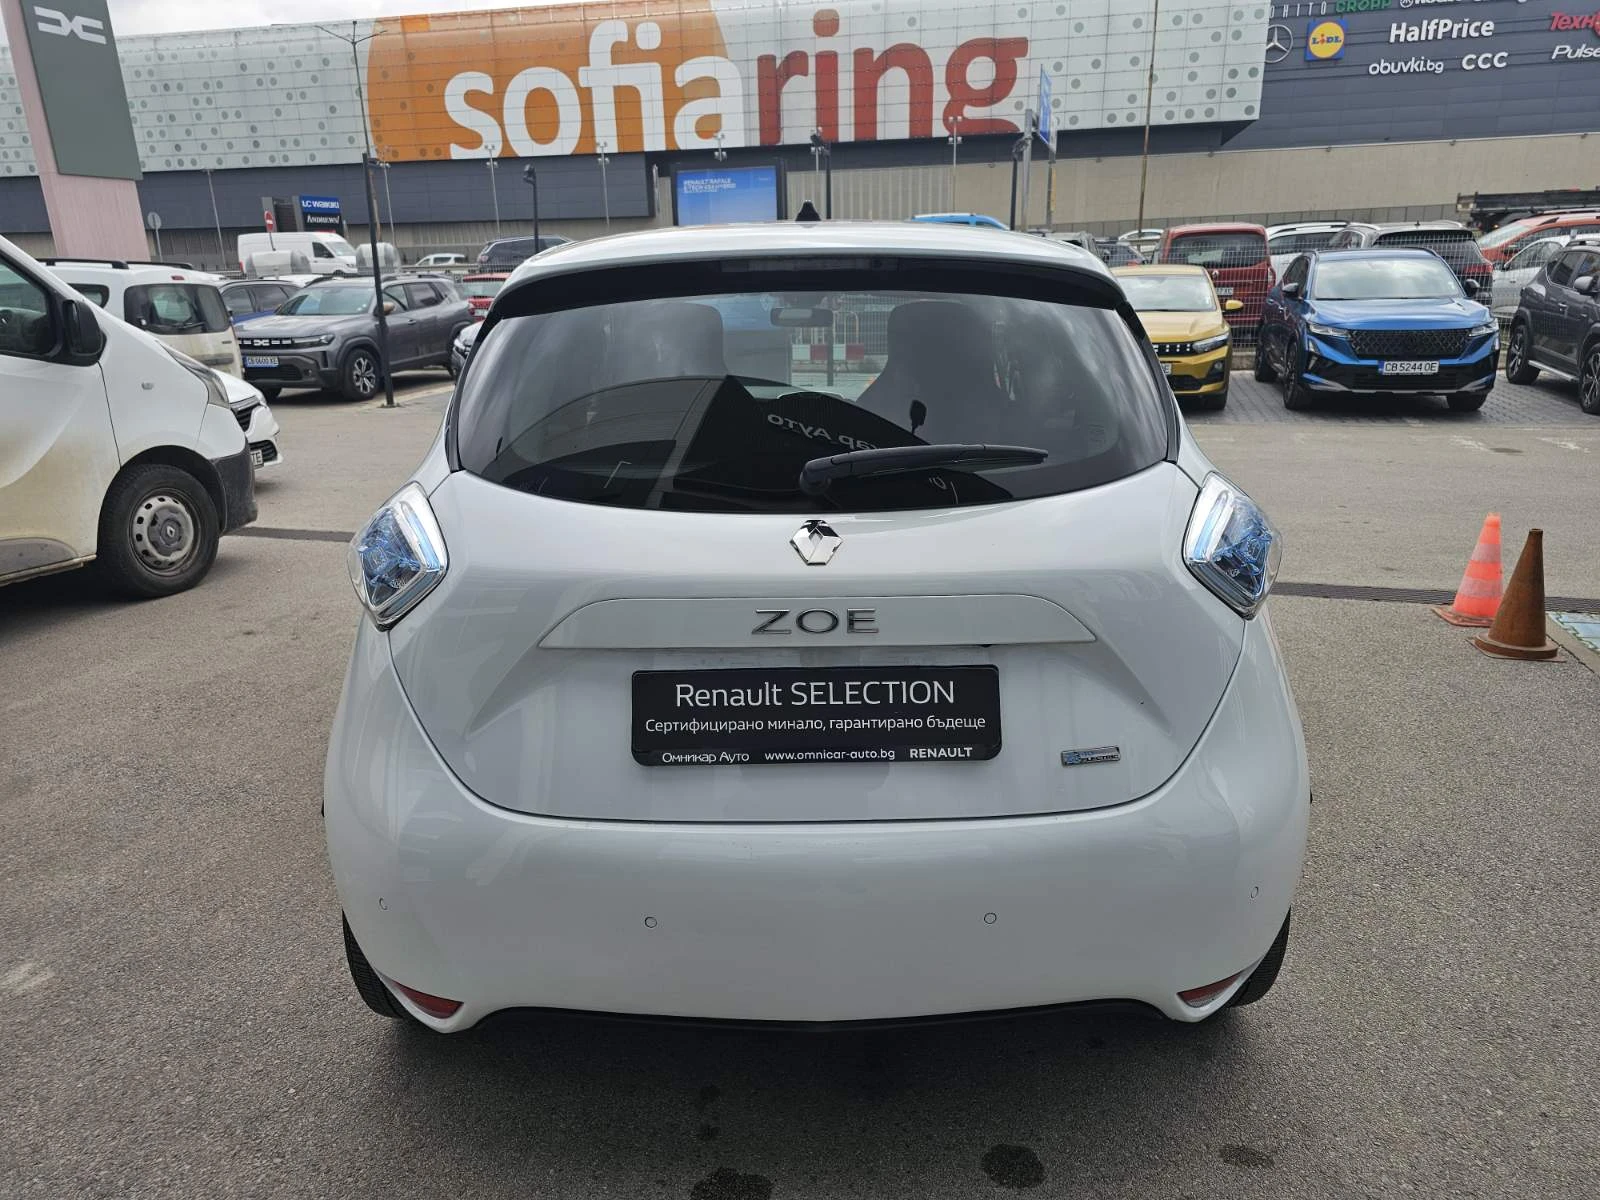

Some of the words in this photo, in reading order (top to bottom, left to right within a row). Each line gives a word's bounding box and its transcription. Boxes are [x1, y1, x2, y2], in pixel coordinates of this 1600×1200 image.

[1389, 18, 1495, 43] HalfPrice
[1368, 56, 1444, 75] obuvki.bg
[1461, 51, 1509, 70] CCC
[1385, 362, 1397, 372] CB
[1399, 362, 1423, 372] 5244
[751, 608, 879, 635] ZOE
[675, 681, 783, 707] Renault
[791, 680, 954, 706] SELECTION
[645, 717, 764, 734] Сертифицирано
[767, 717, 827, 731] минало,
[829, 717, 923, 732] гарантирано
[926, 715, 986, 730] бъдеще
[662, 751, 717, 764] Омникар
[719, 751, 750, 764] Ауто
[764, 748, 896, 761] www.omnicar-auto.bg
[909, 747, 973, 759] RENAULT
